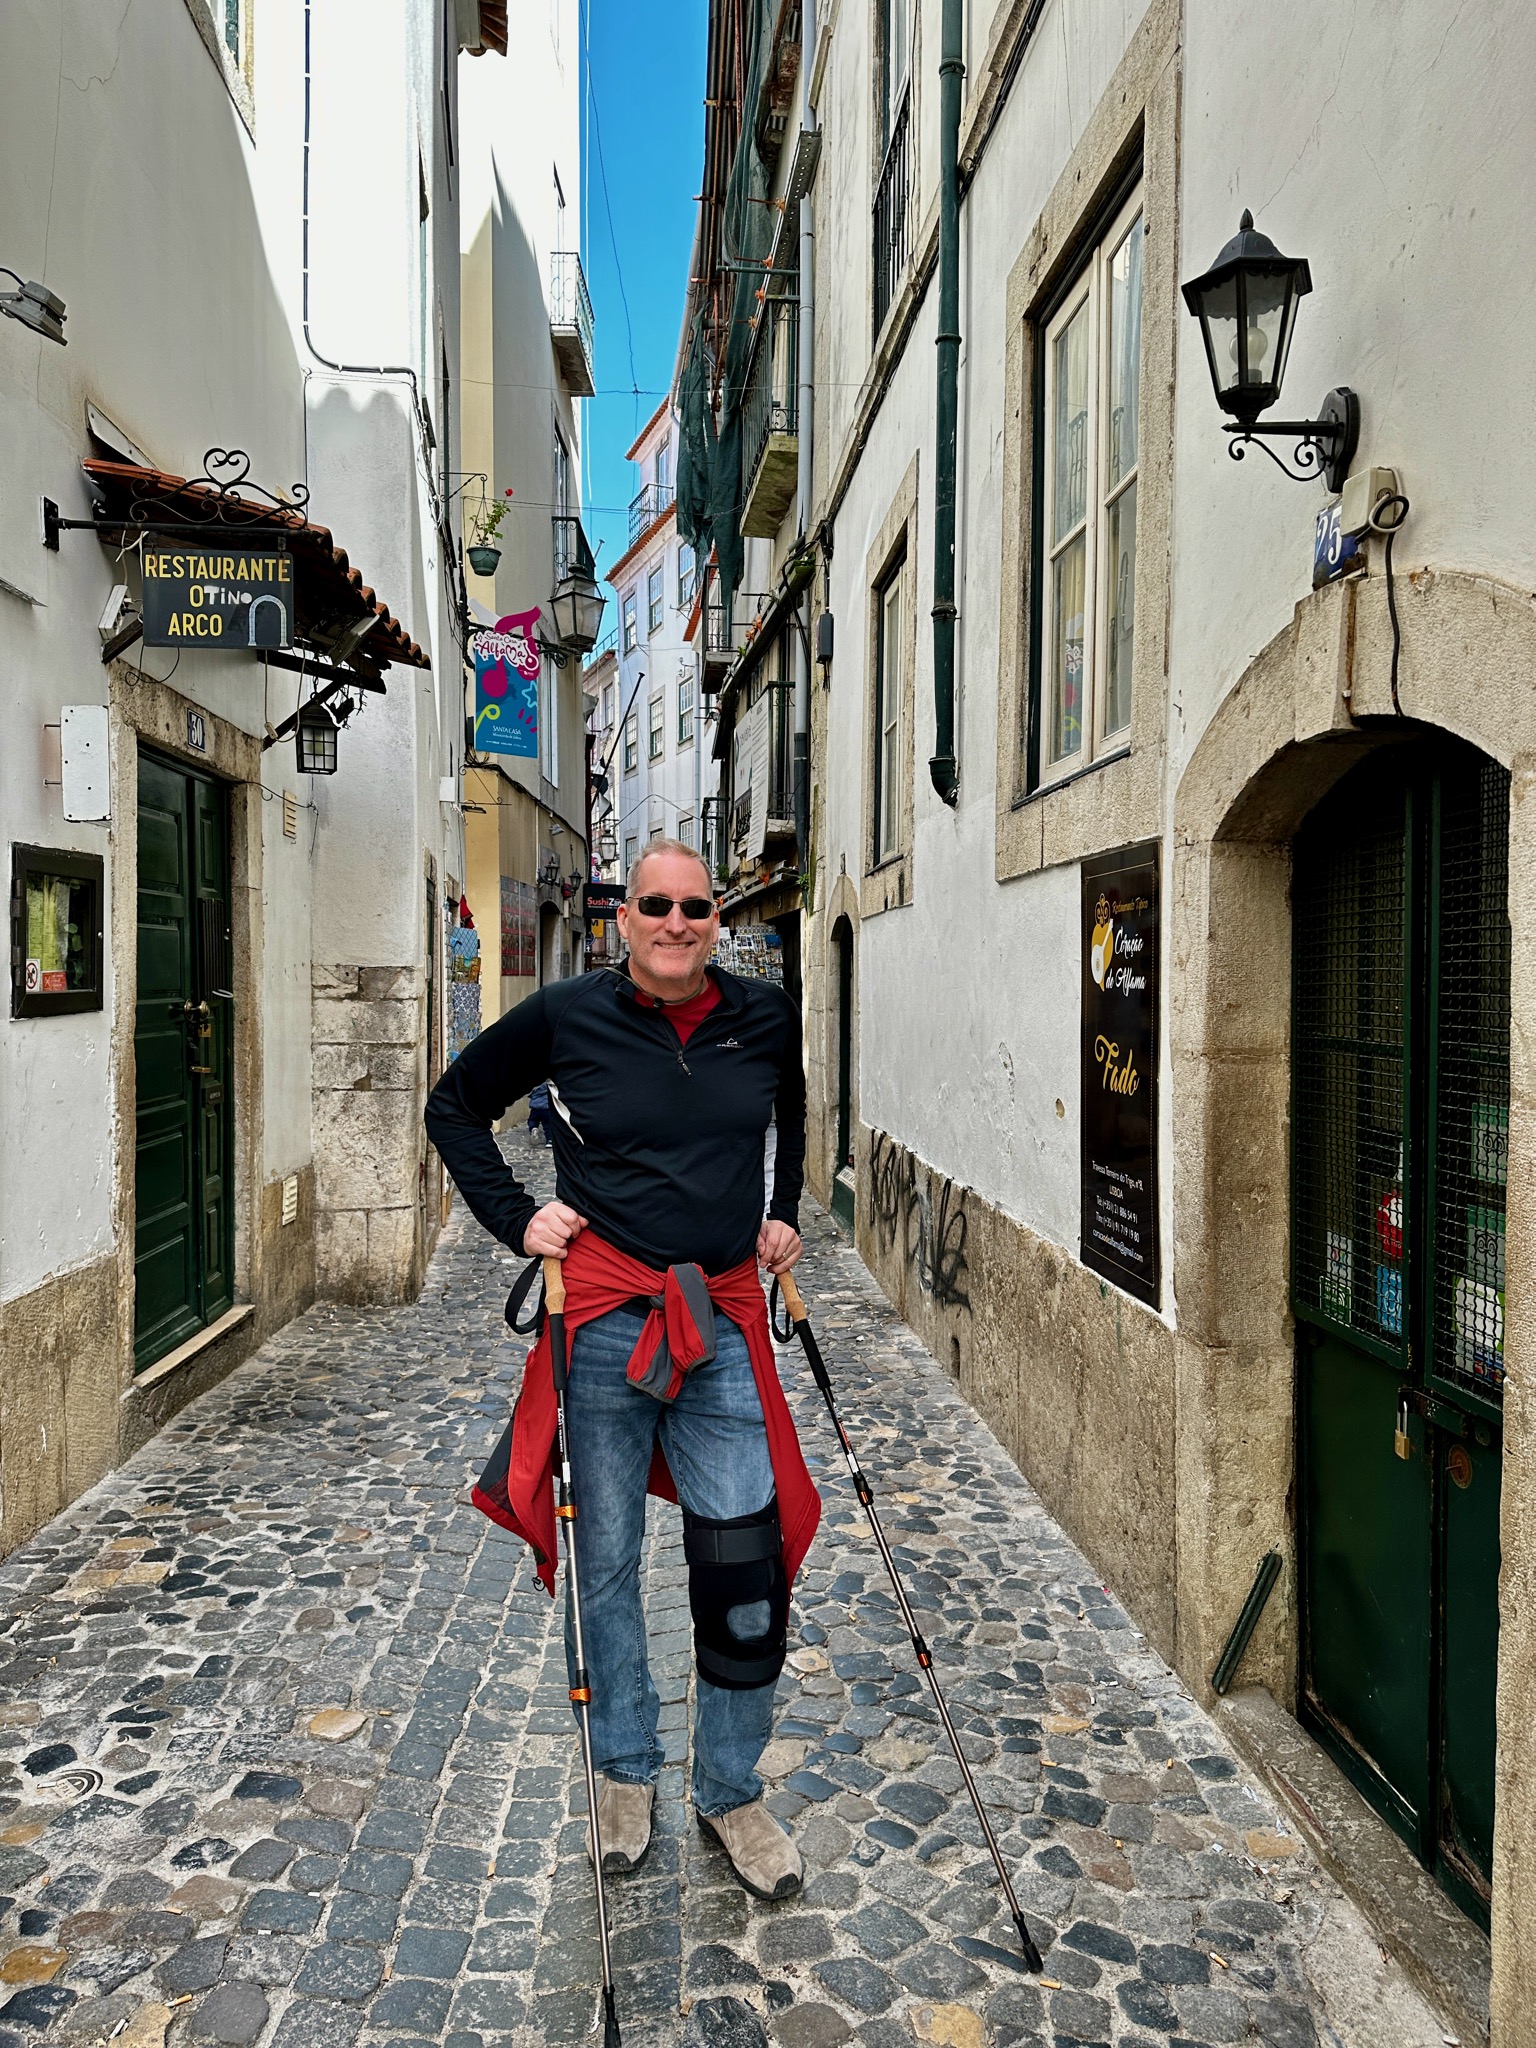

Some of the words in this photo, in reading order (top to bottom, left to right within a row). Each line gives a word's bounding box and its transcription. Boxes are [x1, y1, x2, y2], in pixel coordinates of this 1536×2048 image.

[145, 554, 291, 582] RESTAURANTE
[167, 612, 223, 637] ARCO
[191, 713, 203, 746] 30
[1105, 968, 1115, 989] de
[1115, 967, 1147, 997] Alfama
[1094, 1034, 1140, 1097] Fado
[1109, 1185, 1123, 1199] LISBOA
